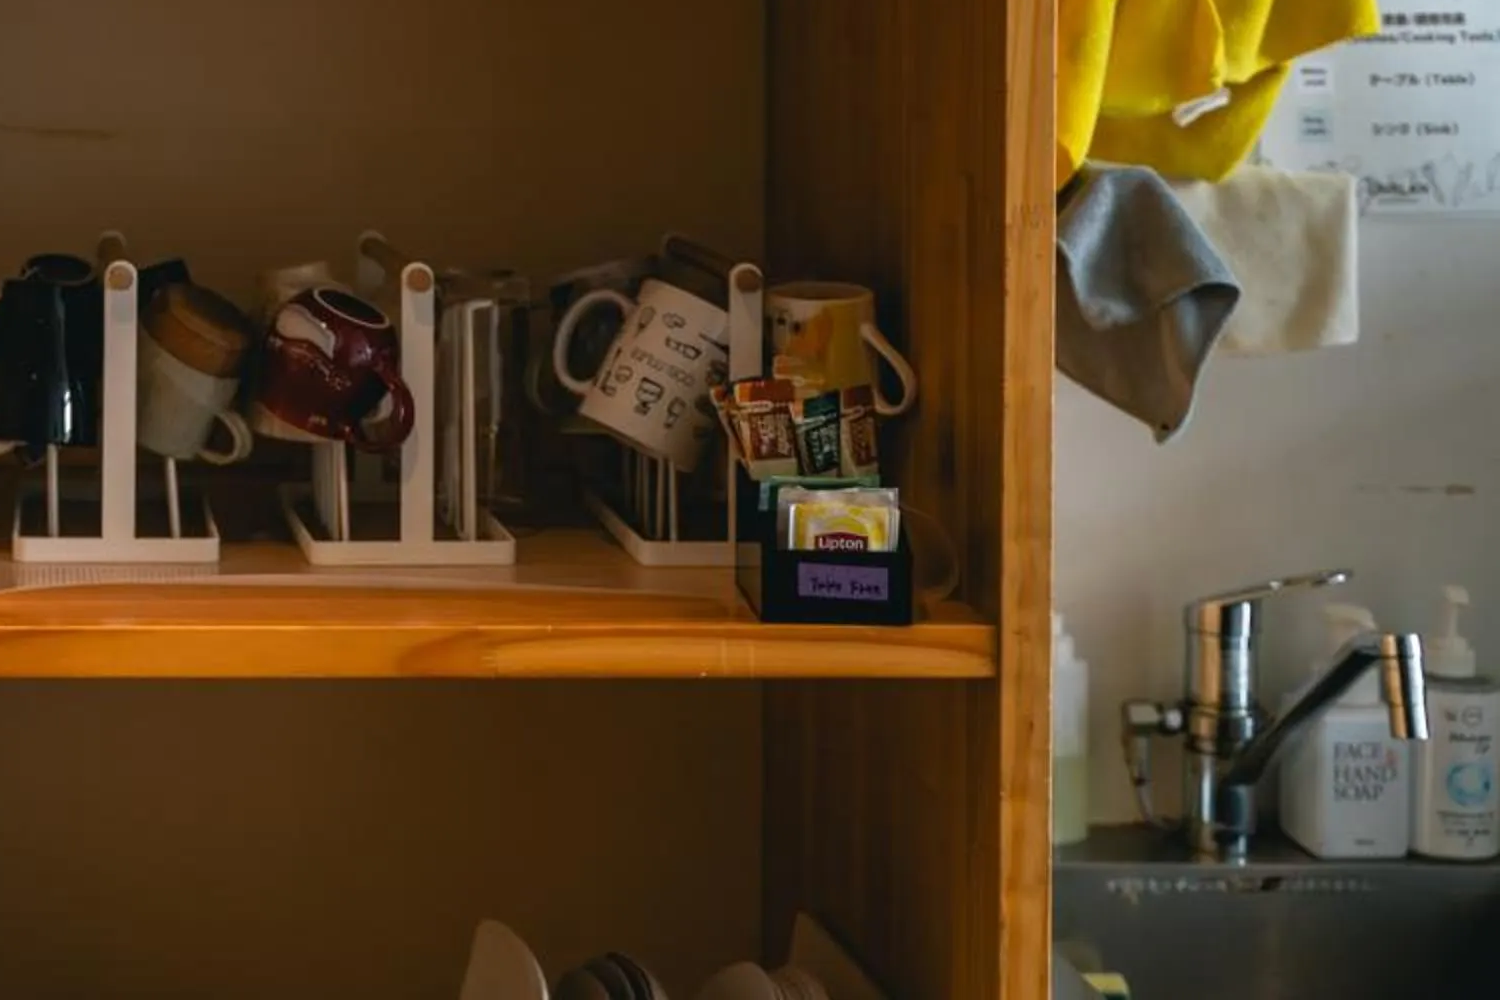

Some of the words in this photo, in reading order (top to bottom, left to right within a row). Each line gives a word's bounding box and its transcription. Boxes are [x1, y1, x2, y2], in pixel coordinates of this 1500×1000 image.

[818, 536, 864, 550] Lipton
[1333, 743, 1383, 760] FACE
[1333, 766, 1397, 784] HAND
[1333, 784, 1385, 801] SOAP
